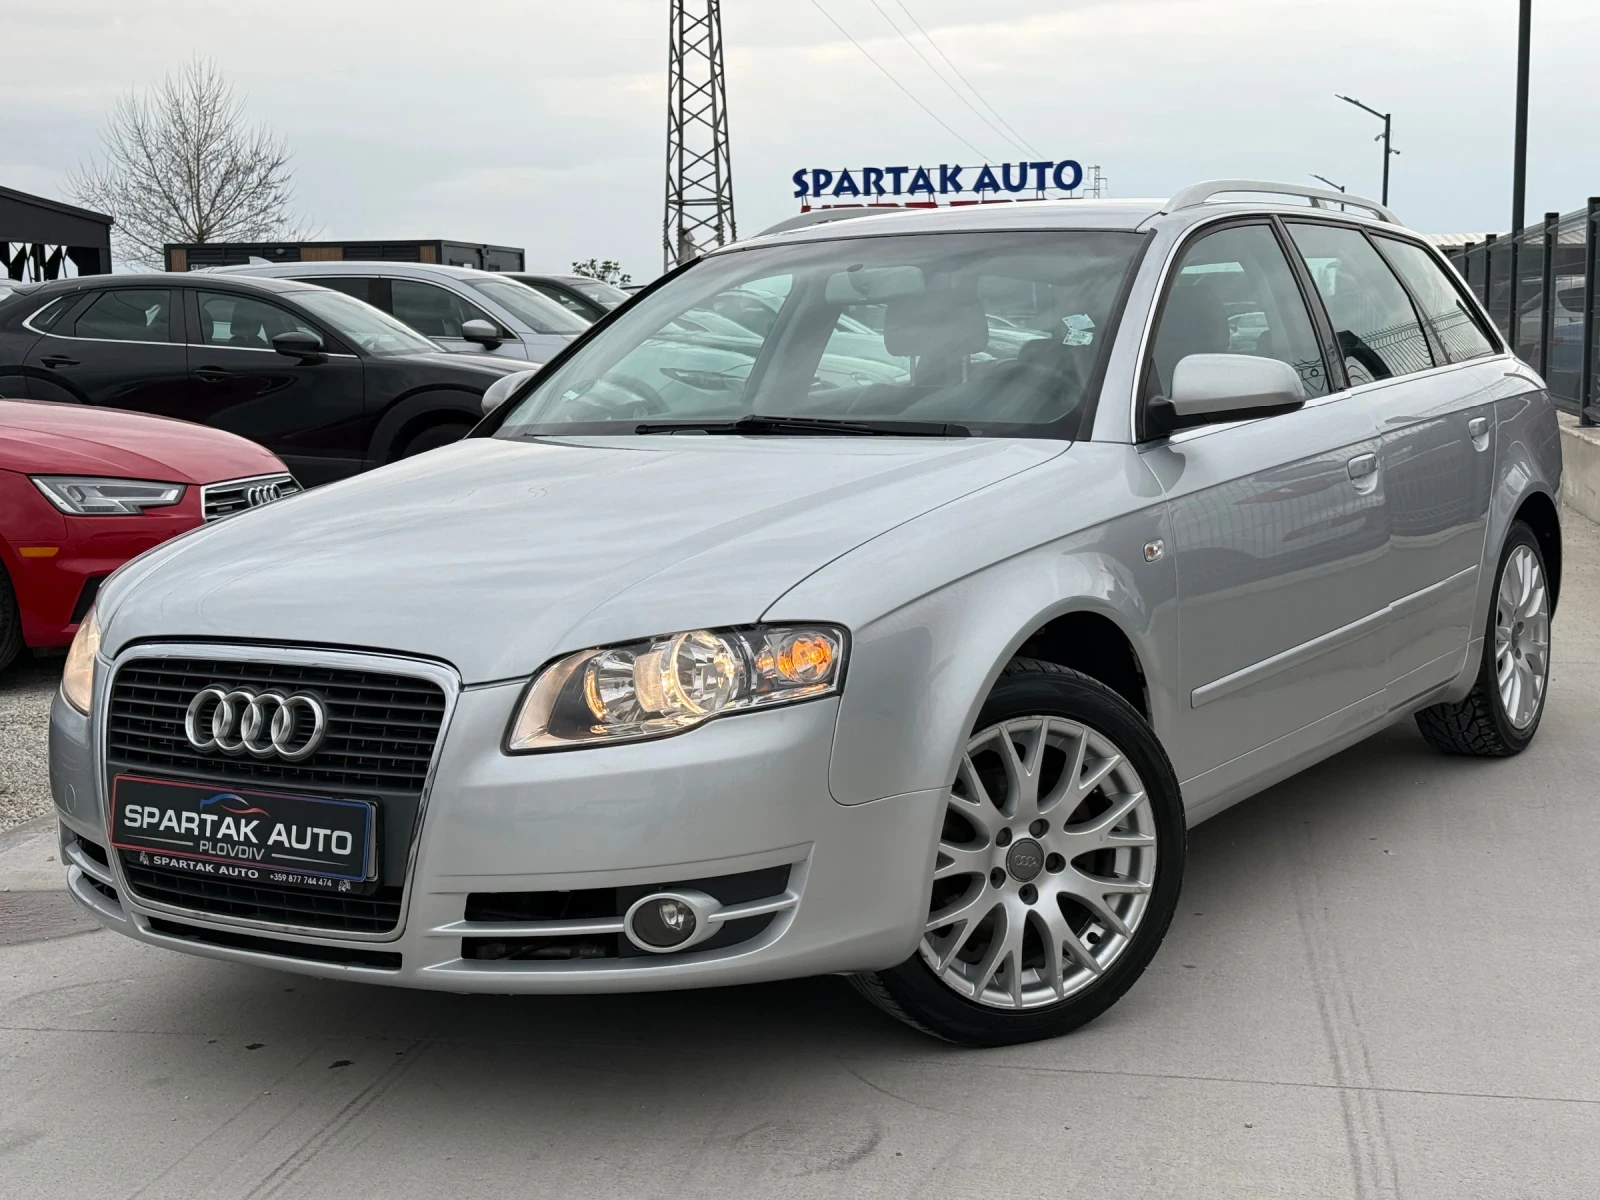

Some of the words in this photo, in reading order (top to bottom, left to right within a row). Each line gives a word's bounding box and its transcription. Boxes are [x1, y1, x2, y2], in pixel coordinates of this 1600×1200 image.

[792, 163, 963, 198] SPARTAK
[973, 160, 1083, 193] AUTO
[124, 804, 260, 844] SPARTAK
[267, 823, 353, 855] AUTO
[199, 839, 265, 861] PLOVDIV
[153, 855, 215, 873] SPARTAK
[218, 865, 259, 879] AUTO
[269, 872, 287, 882] +359
[288, 874, 302, 883] 877
[303, 876, 317, 885] 744
[318, 878, 332, 887] 474
